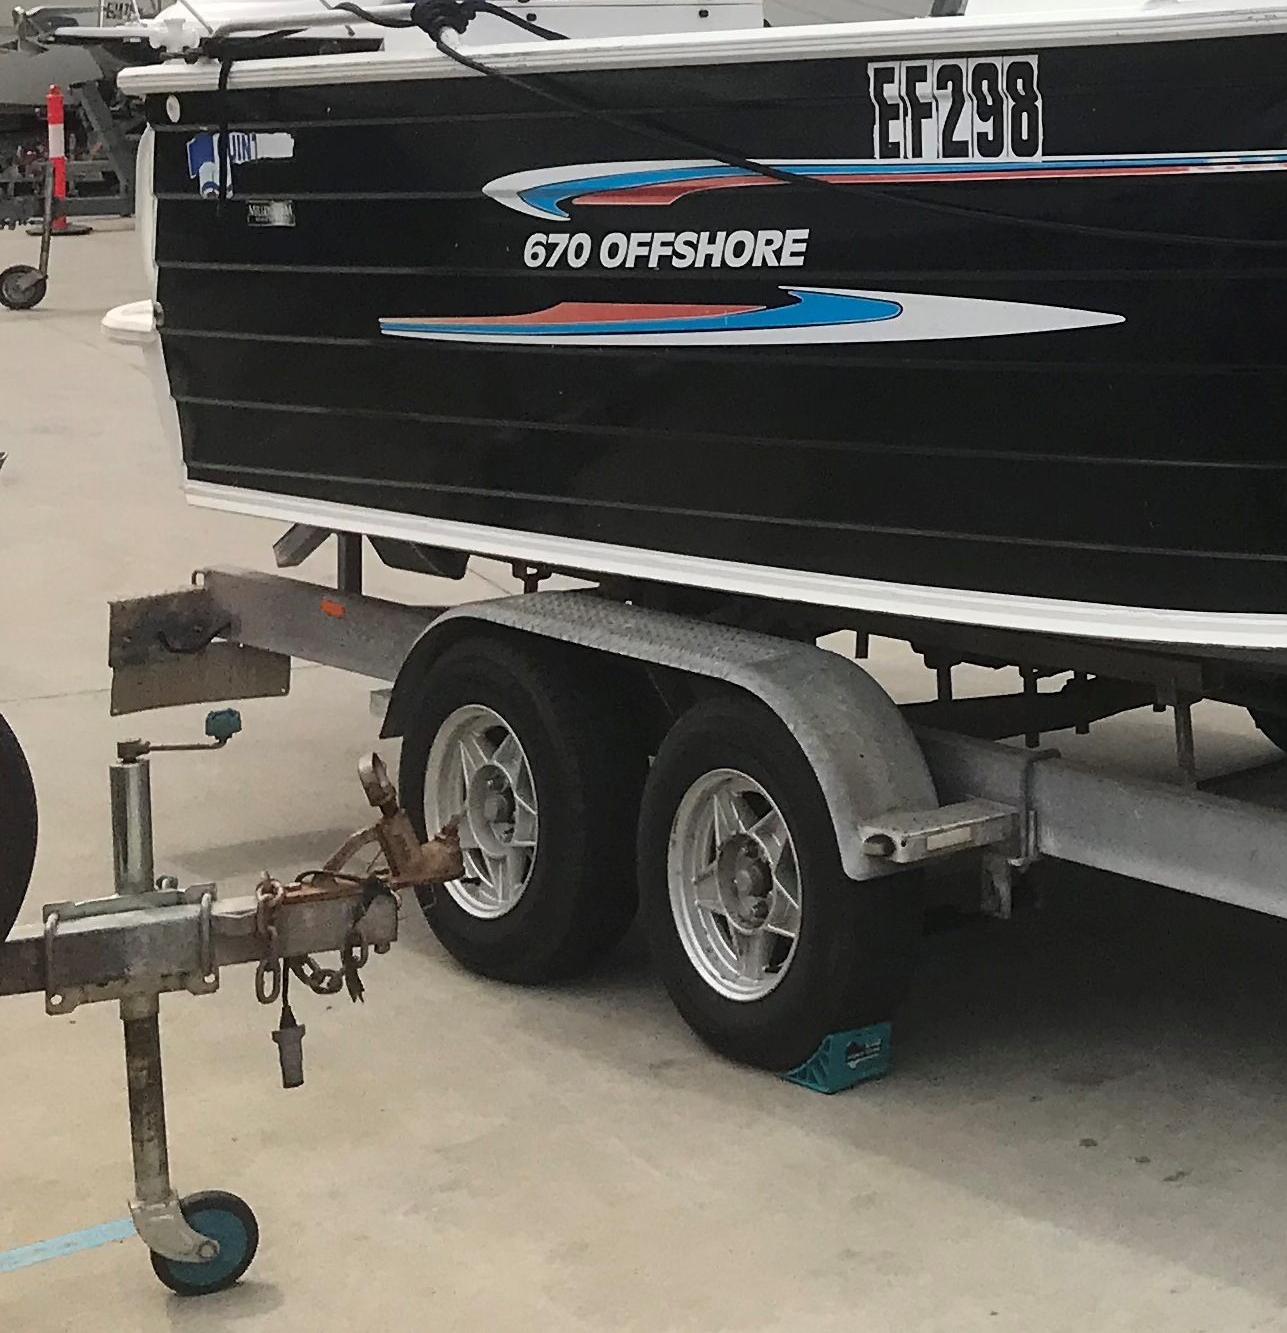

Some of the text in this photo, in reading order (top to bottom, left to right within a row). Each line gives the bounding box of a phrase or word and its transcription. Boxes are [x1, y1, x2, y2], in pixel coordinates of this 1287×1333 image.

[868, 56, 1042, 161] EF298
[523, 228, 810, 268] 670 OFFSHORE
